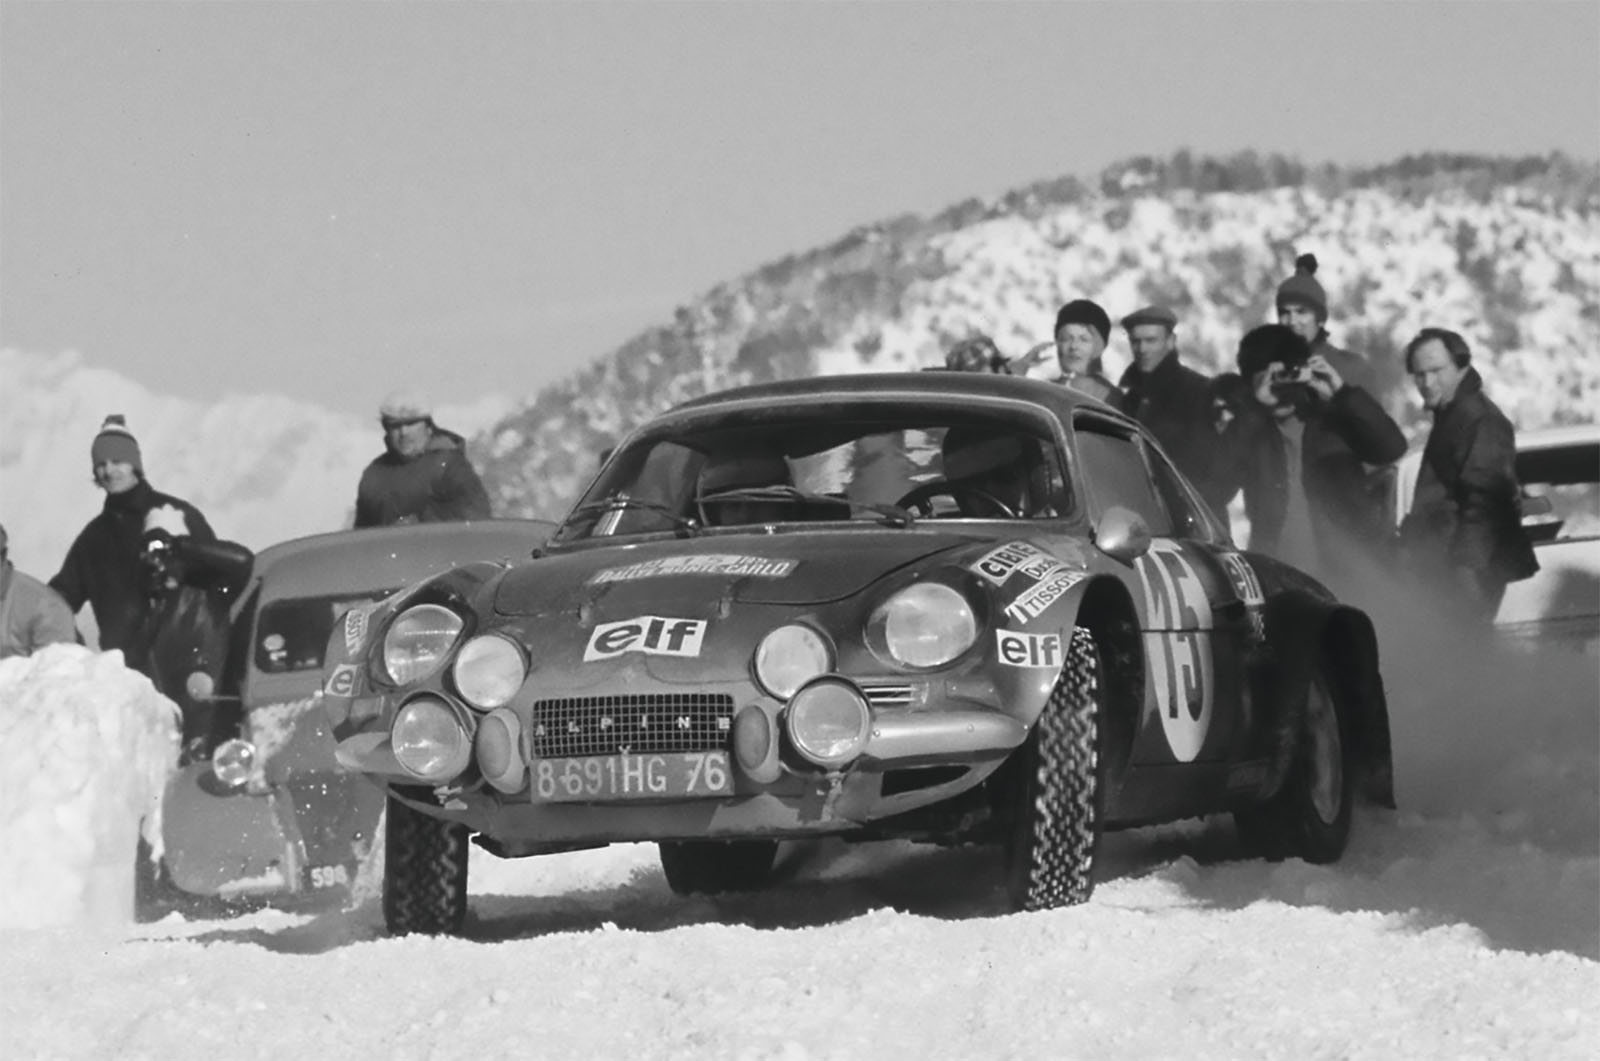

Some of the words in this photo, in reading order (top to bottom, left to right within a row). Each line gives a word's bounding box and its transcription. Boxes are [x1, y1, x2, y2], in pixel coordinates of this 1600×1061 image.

[1024, 575, 1078, 612] TISSOT
[593, 619, 698, 654] elf
[1001, 635, 1059, 667] elf
[535, 714, 731, 737] ALPINE
[684, 752, 726, 793] 76
